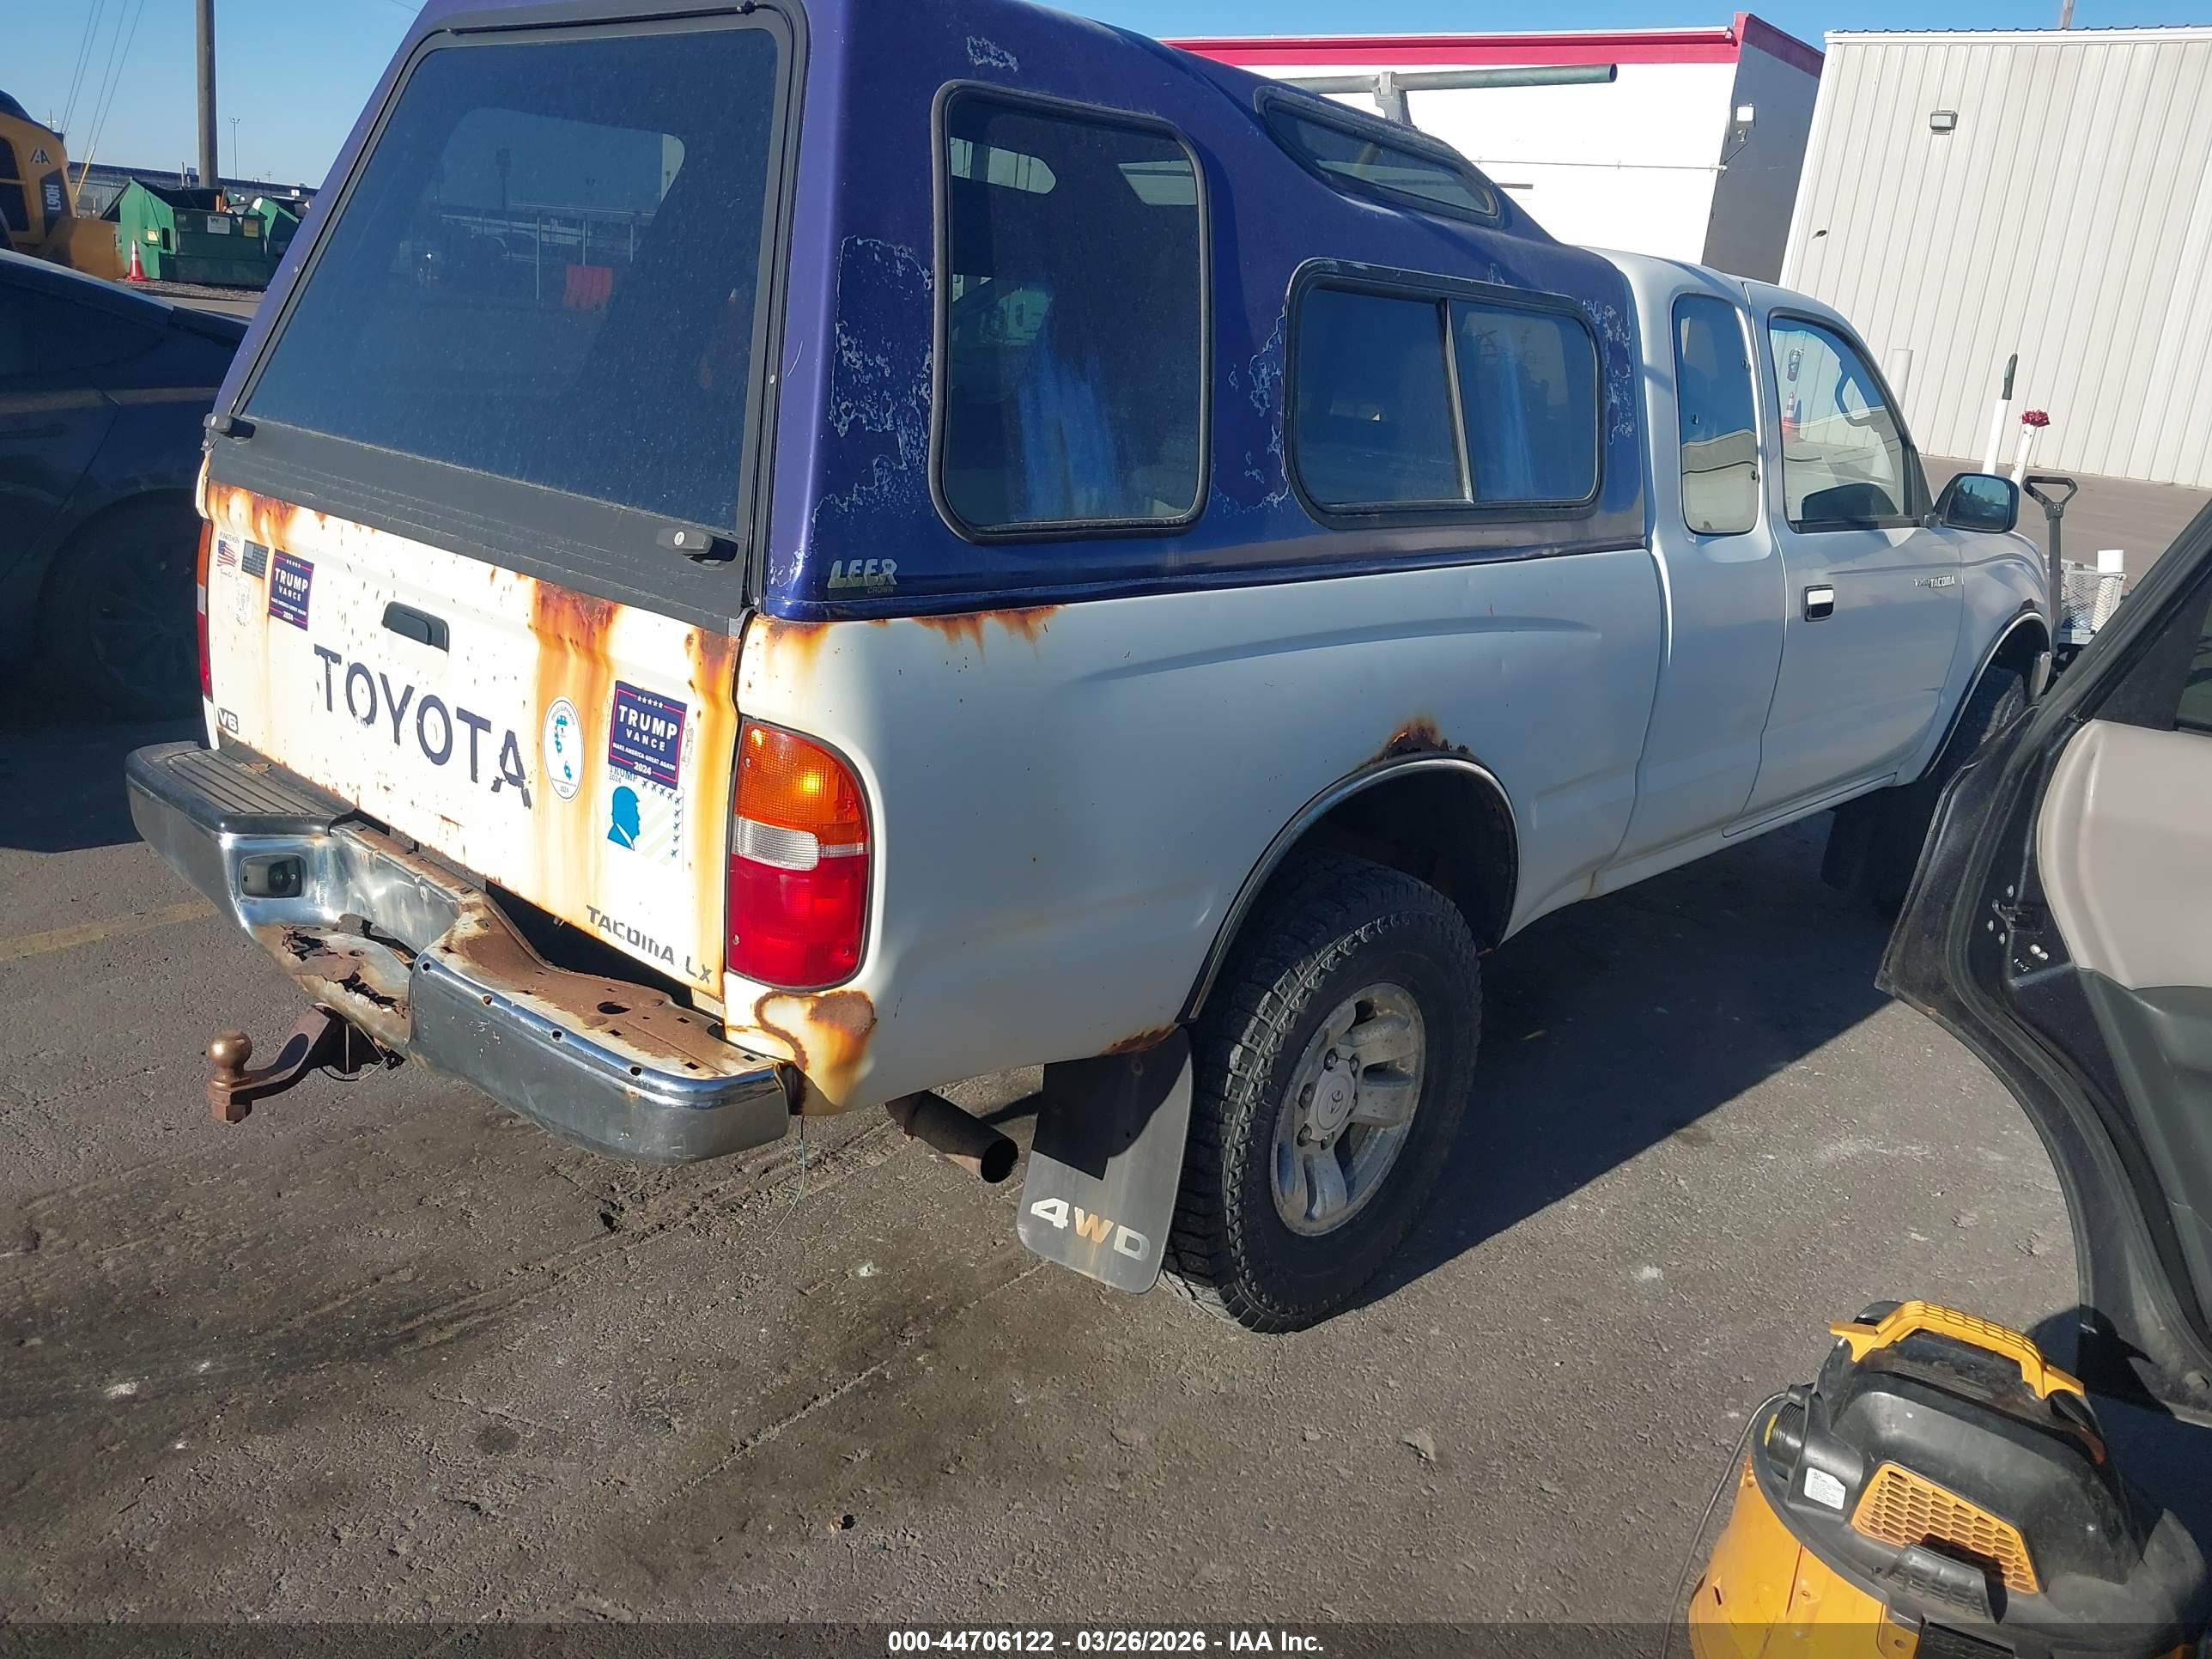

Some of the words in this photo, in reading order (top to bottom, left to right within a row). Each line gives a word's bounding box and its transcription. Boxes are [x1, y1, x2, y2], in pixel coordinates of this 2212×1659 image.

[275, 567, 309, 592] TRUMP
[827, 558, 898, 589] LEER
[278, 585, 301, 602] VANCE
[218, 708, 239, 733] V6
[314, 643, 532, 809] TOYOTA
[618, 704, 678, 740] TRUMP
[625, 728, 666, 752] VANCE
[634, 761, 652, 775] 2024
[685, 955, 713, 985] LX
[1030, 1198, 1151, 1261] 4WD
